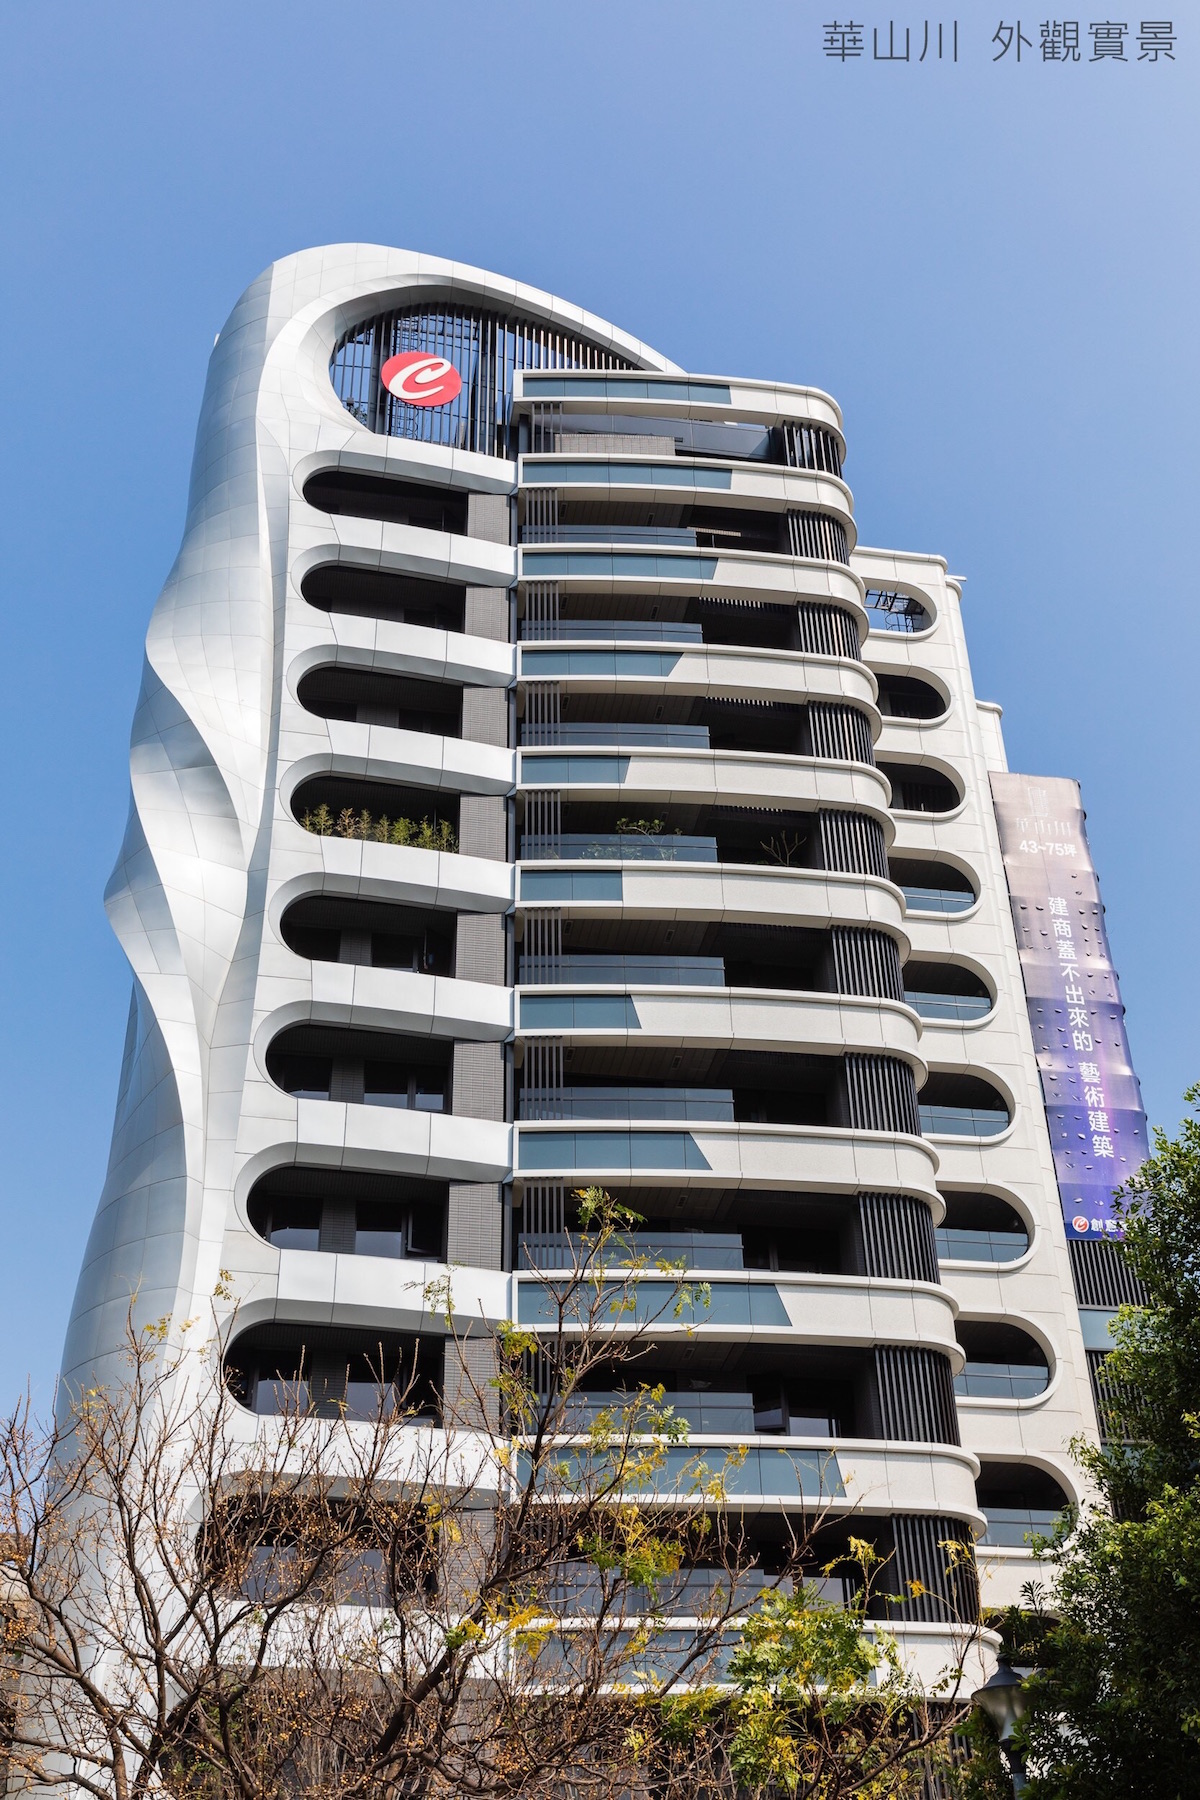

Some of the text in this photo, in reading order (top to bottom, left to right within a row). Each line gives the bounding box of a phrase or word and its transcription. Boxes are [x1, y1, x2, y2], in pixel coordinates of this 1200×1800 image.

[1019, 839, 1078, 858] 43~75坪
[1047, 896, 1115, 1158] 建商蓋不出來的 藝術建築
